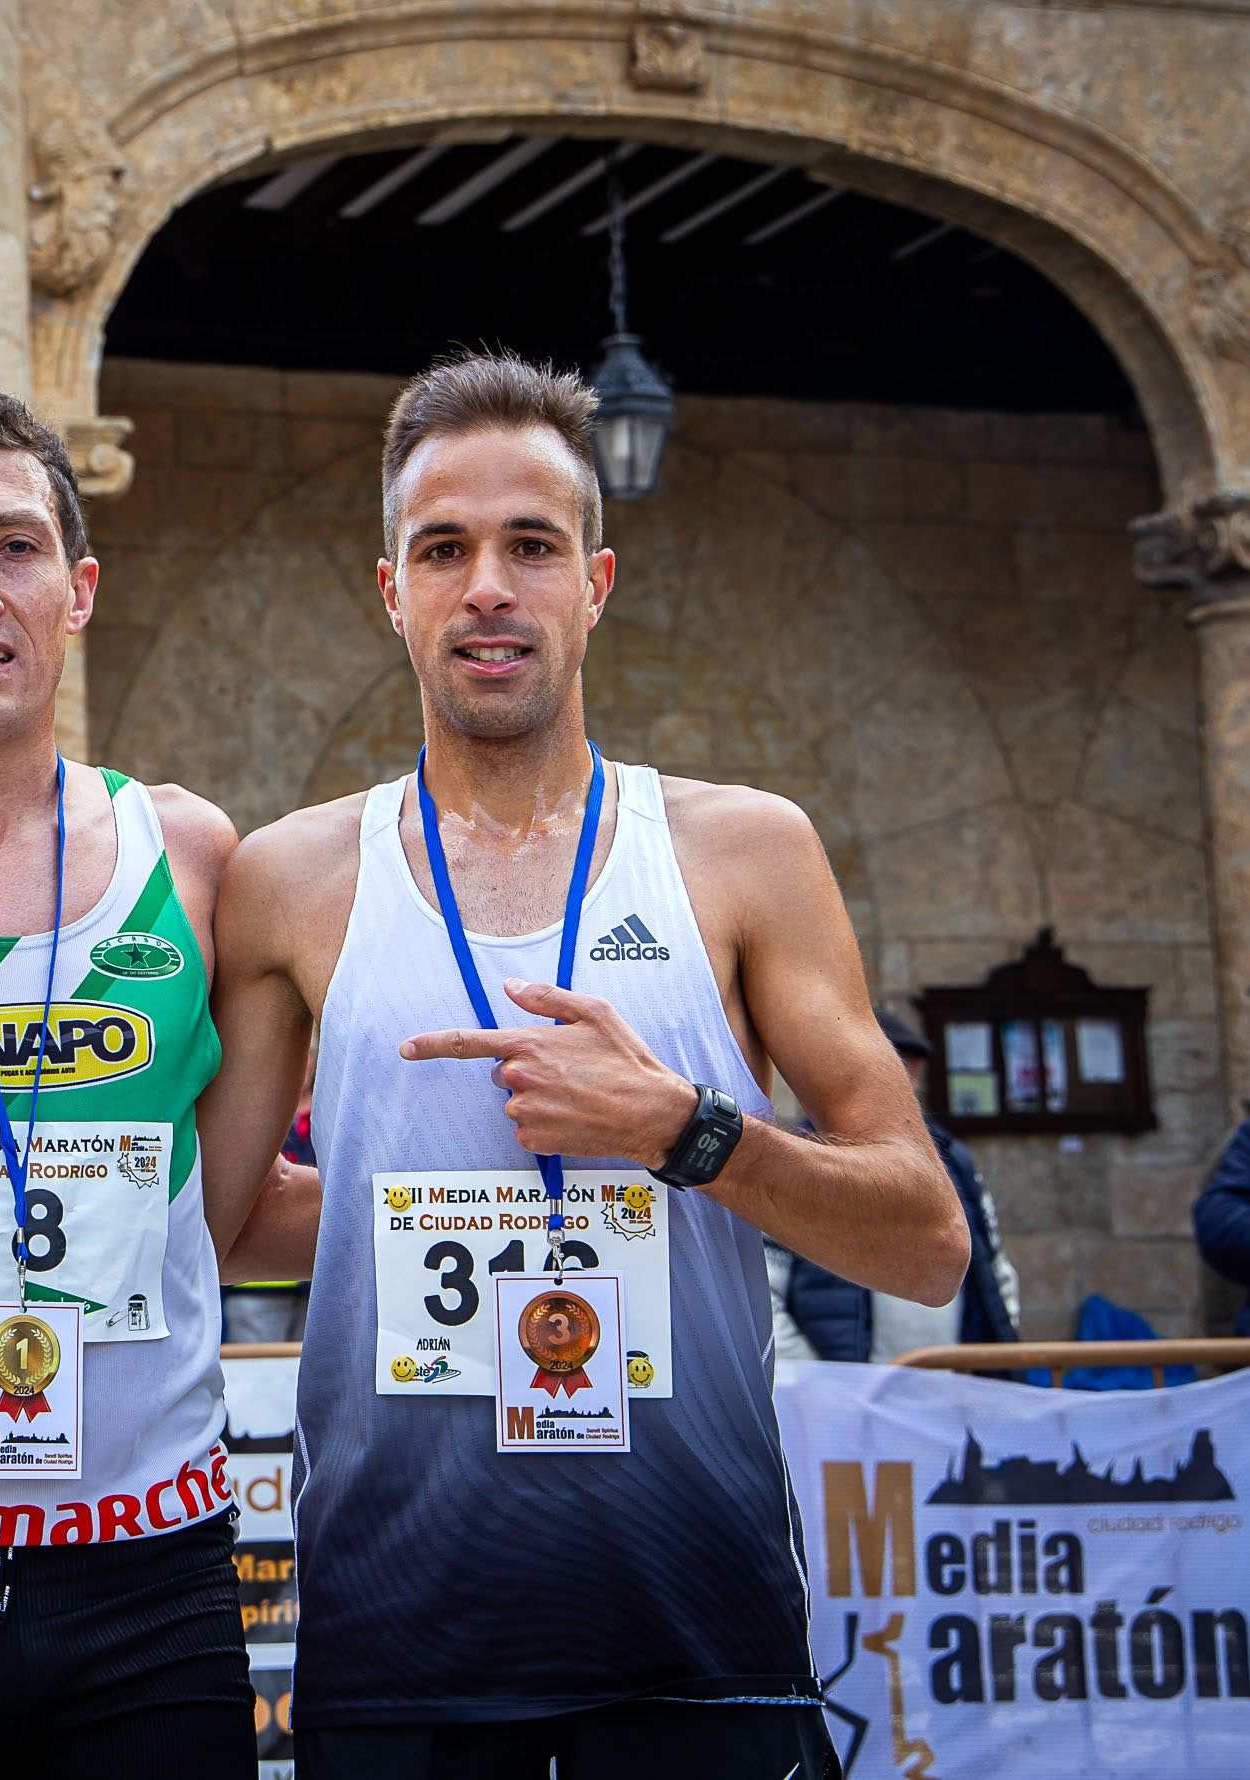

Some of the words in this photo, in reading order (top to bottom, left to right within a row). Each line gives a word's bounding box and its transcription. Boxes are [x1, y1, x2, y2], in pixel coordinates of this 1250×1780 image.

[589, 943, 670, 961] adidas
[26, 1134, 114, 1153] MARATÓN
[29, 1162, 108, 1179] RODRIGO
[134, 1155, 157, 1168] 2024
[429, 1187, 489, 1204] MEDIA
[496, 1183, 595, 1203] MARAÓN
[12, 1188, 67, 1273] 8
[390, 1216, 414, 1231] DE
[419, 1213, 493, 1231] CIUDAD
[498, 1213, 589, 1230] RODGO
[547, 1312, 571, 1346] 3
[416, 1335, 451, 1352] ADRIÁN
[15, 1337, 29, 1370] 1
[549, 1359, 574, 1371] 2024
[13, 1385, 35, 1395] 2024
[1087, 1512, 1164, 1534] ciudad
[1169, 1512, 1242, 1536] rodrigo
